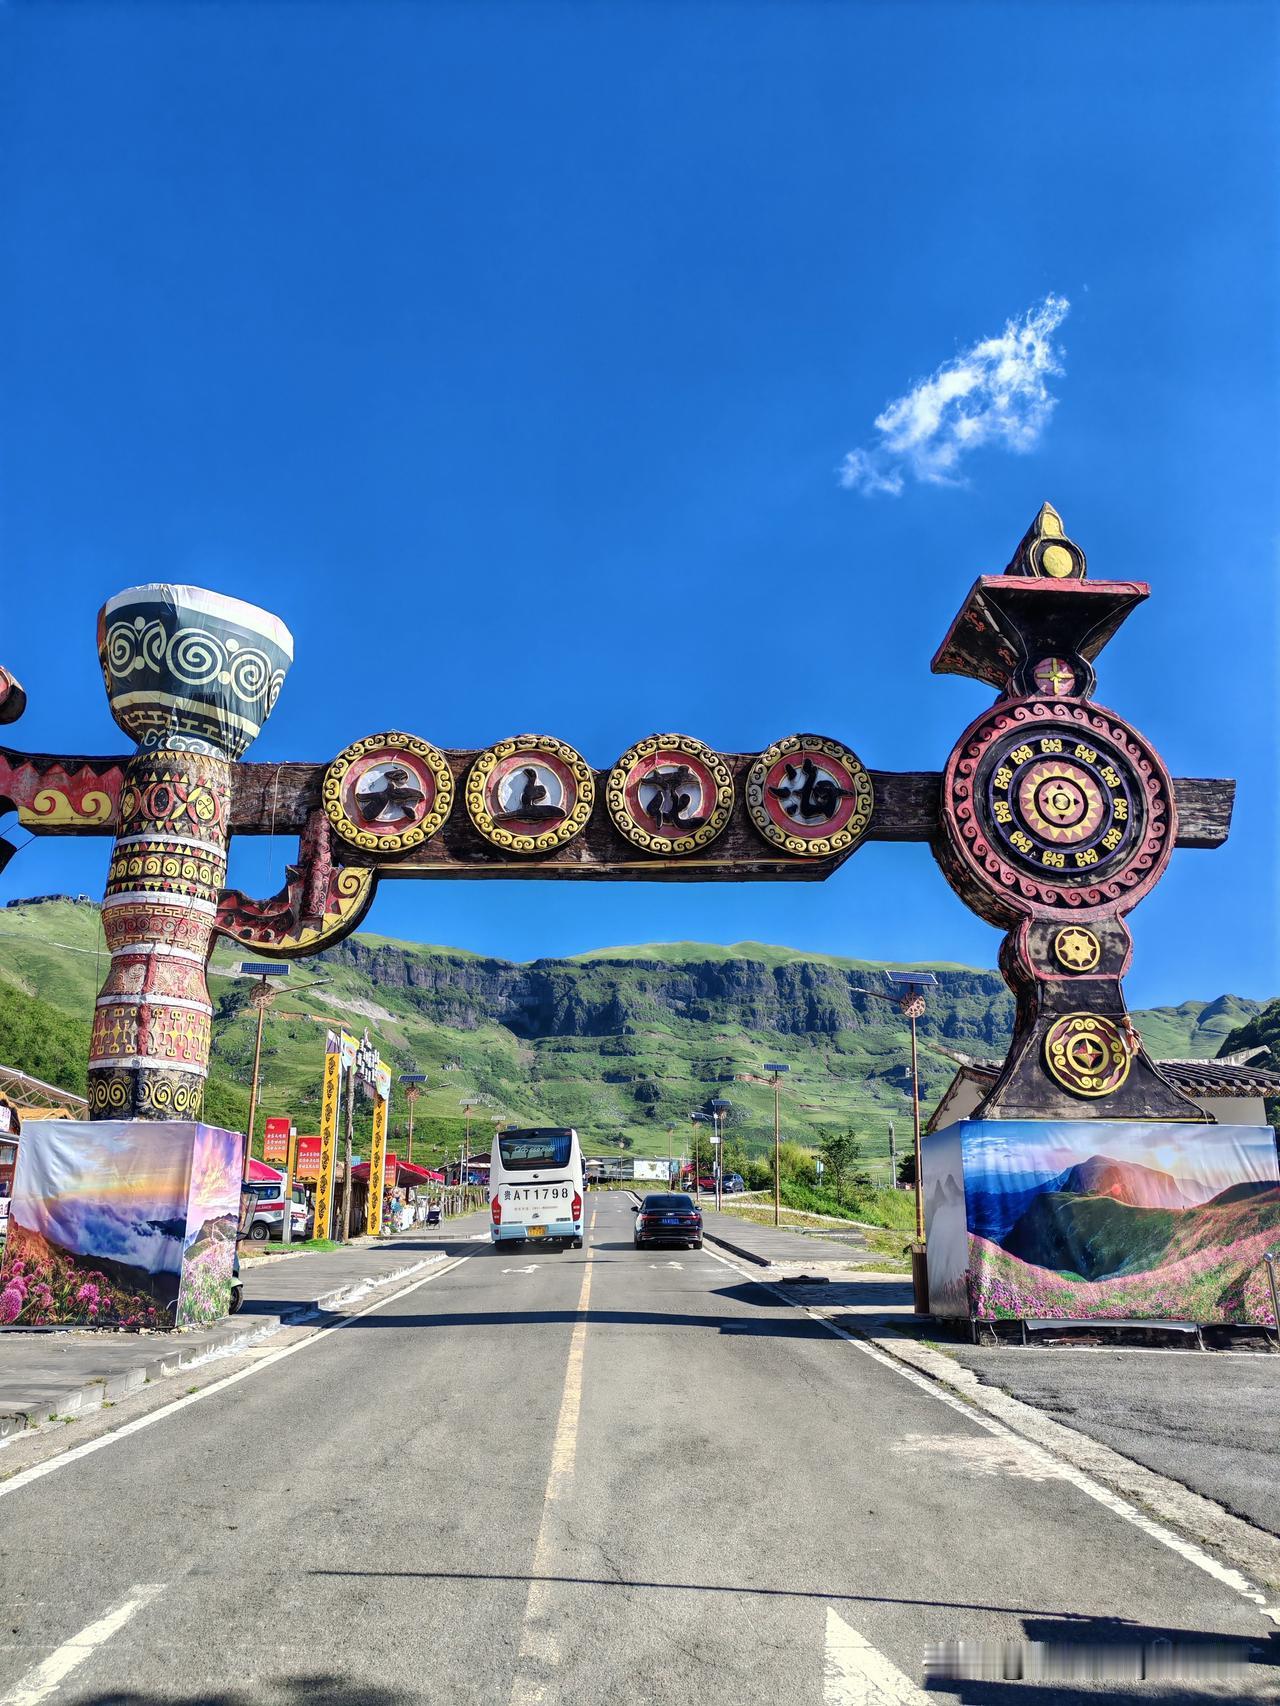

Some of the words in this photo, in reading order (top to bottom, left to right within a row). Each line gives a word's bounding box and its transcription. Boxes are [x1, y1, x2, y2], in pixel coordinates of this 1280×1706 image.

[355, 758, 854, 829] 天上花海
[503, 1187, 569, 1201] 贵AT1798
